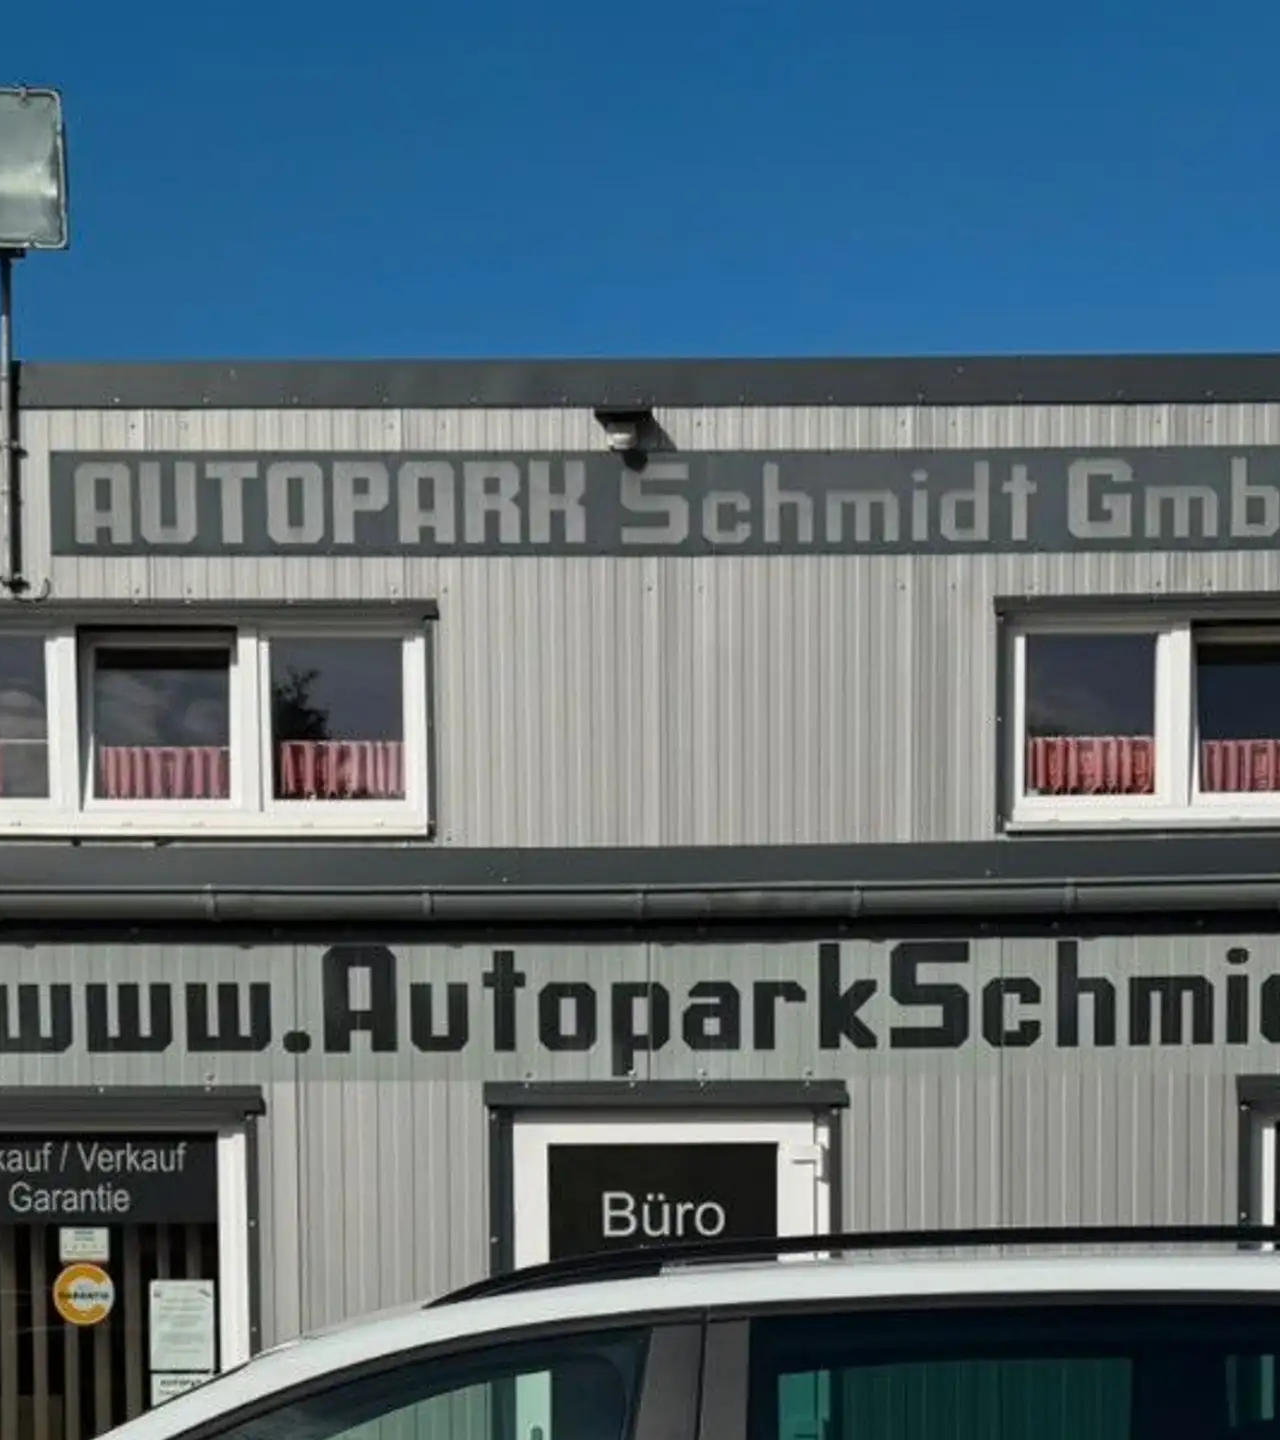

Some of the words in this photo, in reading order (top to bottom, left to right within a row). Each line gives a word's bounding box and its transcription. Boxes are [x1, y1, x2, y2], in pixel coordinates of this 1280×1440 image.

[73, 460, 586, 545] AUTOPARK
[620, 460, 1038, 545] Schmidt
[77, 1141, 189, 1173] Verkauf
[8, 1181, 133, 1215] Garantie
[601, 1190, 727, 1238] Büro
